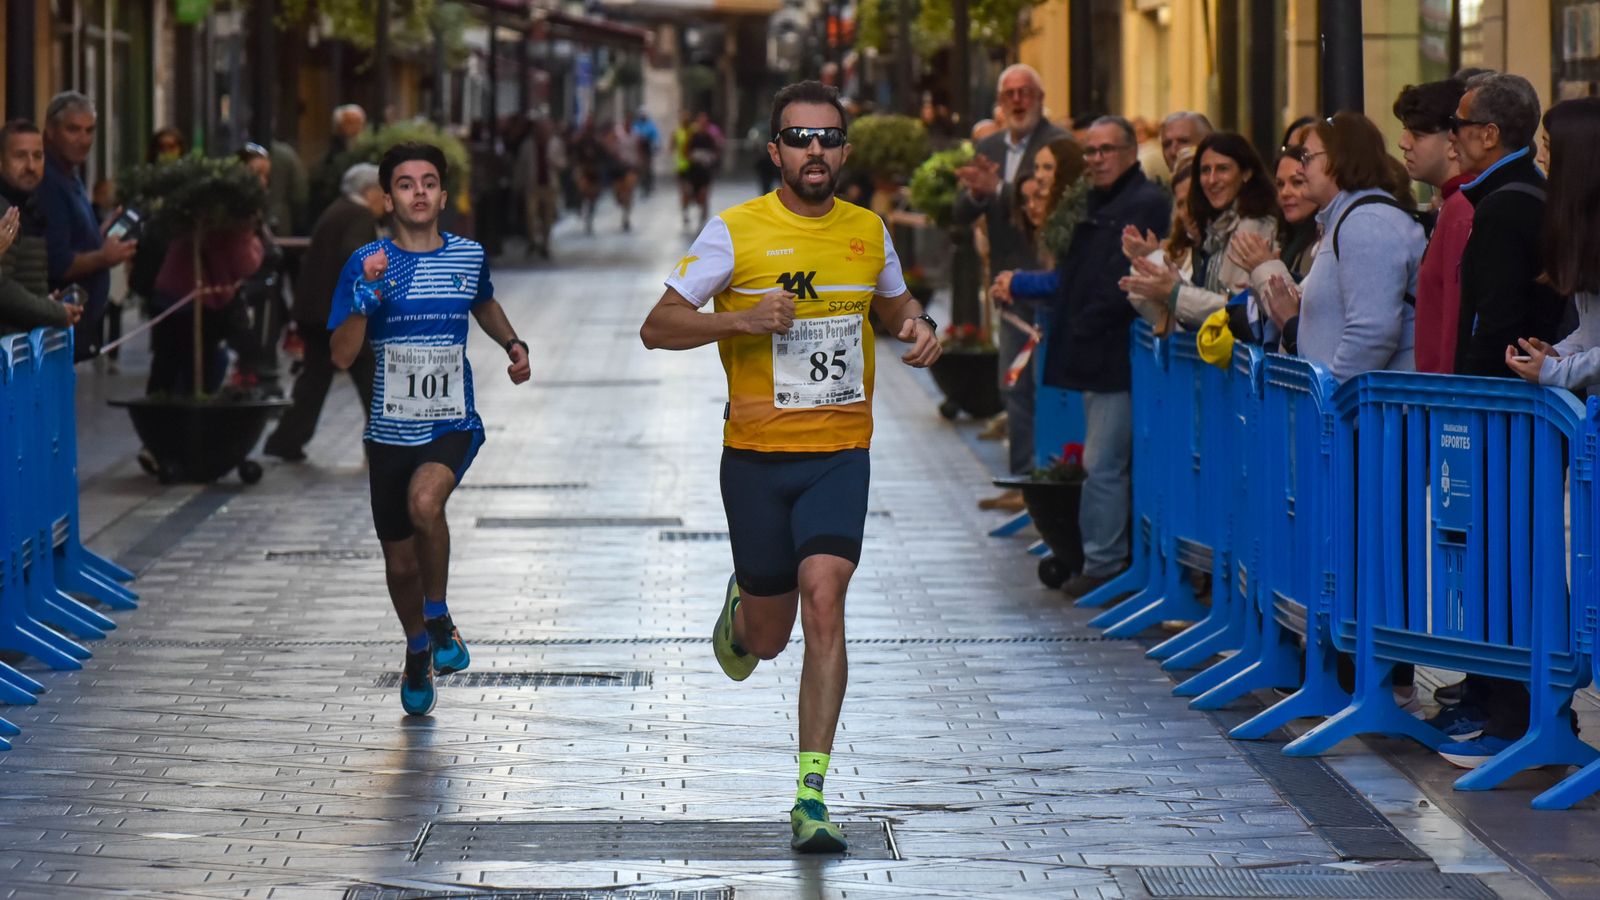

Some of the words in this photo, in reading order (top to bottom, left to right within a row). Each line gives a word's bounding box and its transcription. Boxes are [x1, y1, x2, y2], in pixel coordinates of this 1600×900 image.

[766, 247, 794, 257] FASTER
[828, 300, 867, 312] STORE
[809, 349, 847, 382] 85
[406, 373, 451, 400] 101
[1441, 435, 1470, 449] DEPORTES
